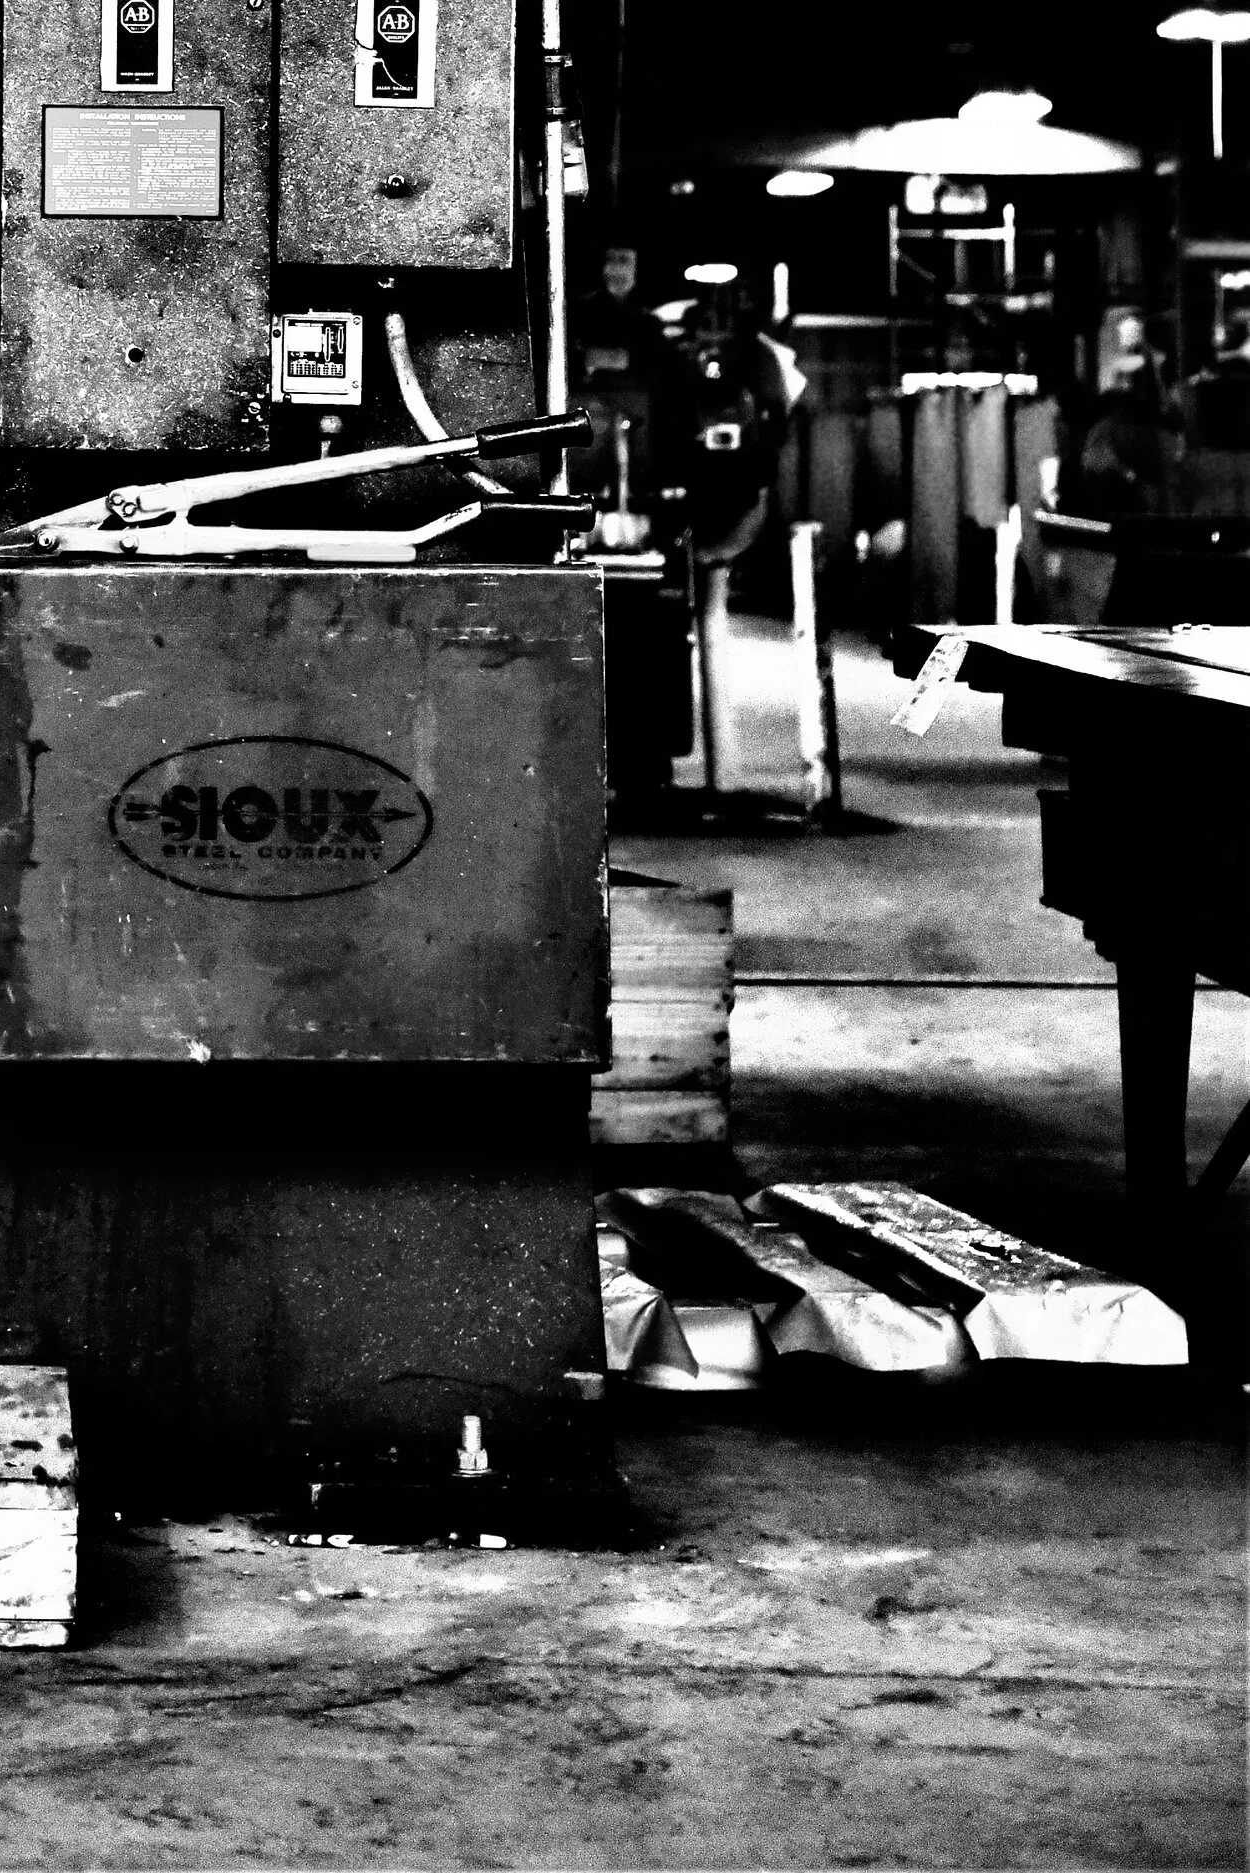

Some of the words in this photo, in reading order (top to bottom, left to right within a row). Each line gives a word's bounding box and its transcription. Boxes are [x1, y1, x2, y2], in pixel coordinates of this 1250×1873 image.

[160, 785, 385, 843] SIOUX
[162, 844, 242, 859] STEEL
[257, 845, 384, 860] COMPANY
